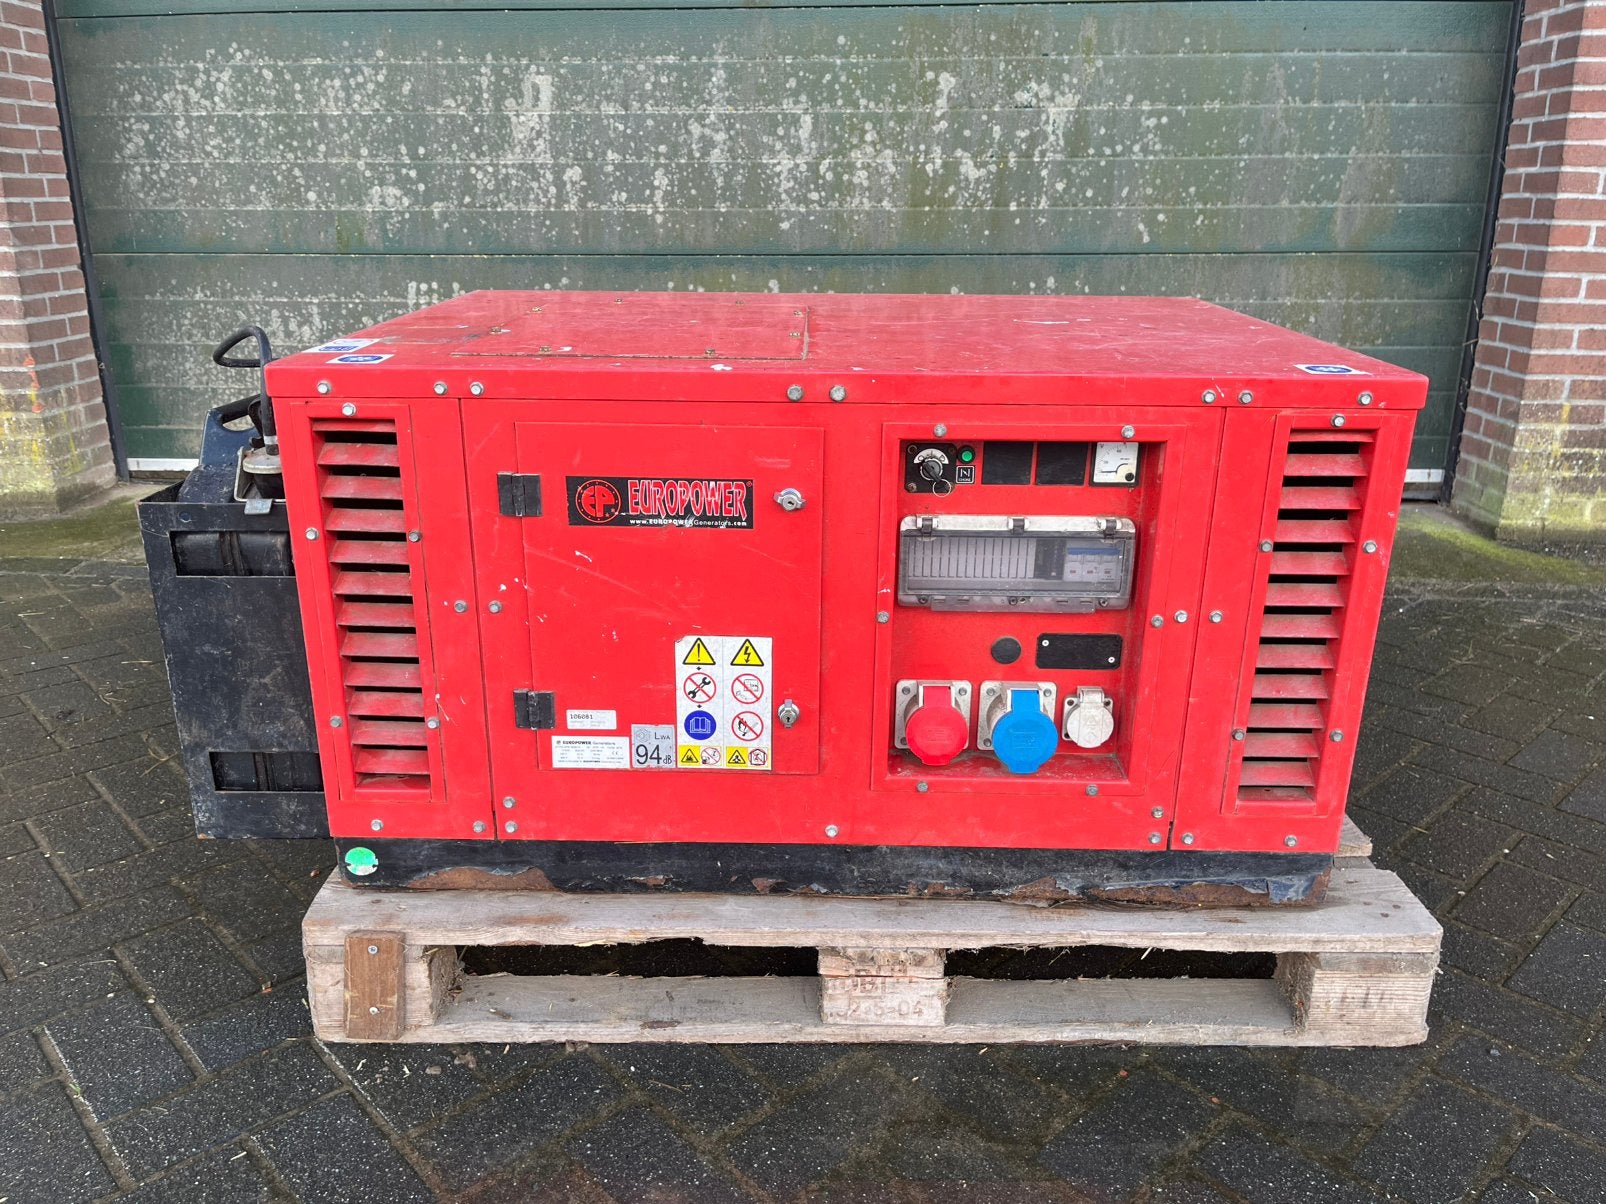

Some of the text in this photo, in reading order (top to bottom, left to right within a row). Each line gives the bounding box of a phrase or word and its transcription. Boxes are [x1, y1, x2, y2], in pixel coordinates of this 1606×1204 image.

[627, 479, 748, 521] EUROPOWER
[635, 744, 662, 765] 94
[662, 754, 673, 765] dB
